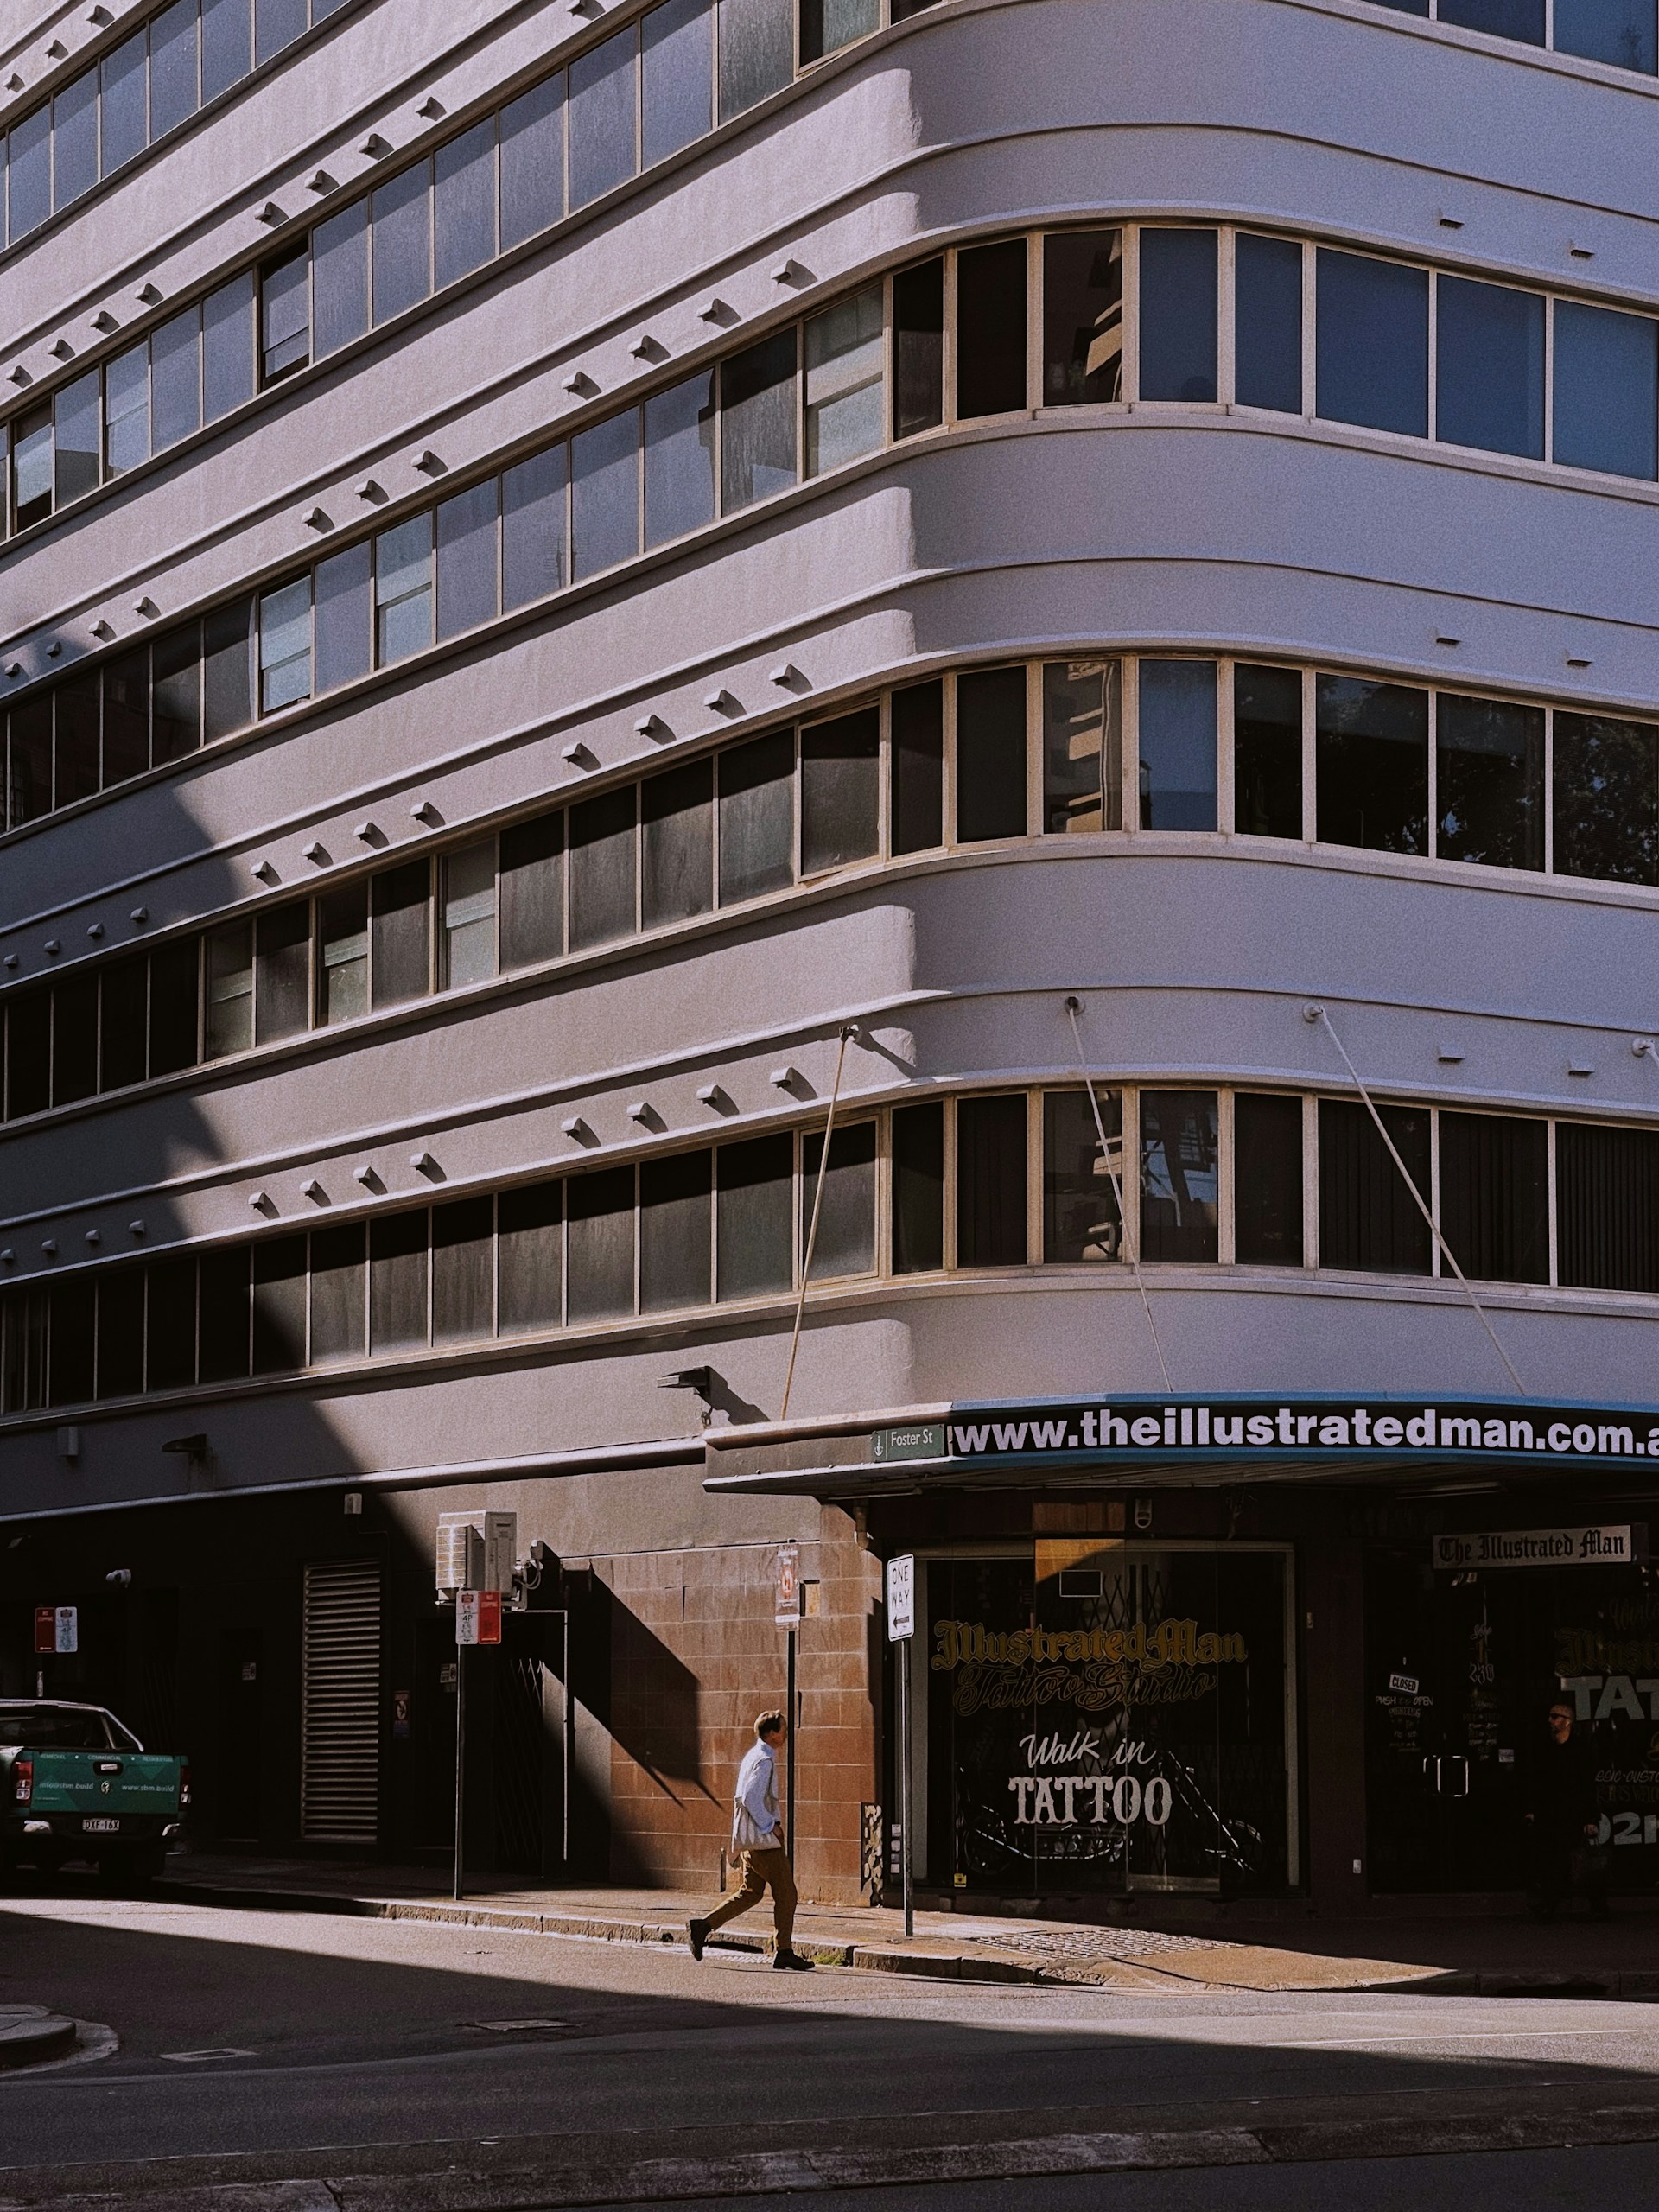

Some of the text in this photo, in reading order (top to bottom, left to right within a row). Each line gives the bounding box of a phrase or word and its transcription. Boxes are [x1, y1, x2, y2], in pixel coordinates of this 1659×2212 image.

[891, 1428, 933, 1446] Foster St
[1437, 1529, 1624, 1565] The Illustrated Man
[892, 1565, 909, 1585] ONE
[892, 1589, 909, 1609] WAY
[931, 1618, 1245, 1672] Illustrated Man
[1391, 1676, 1417, 1692] CLOSED
[1468, 1661, 1496, 1685] 230
[953, 1662, 1217, 1716] Tattoo Studio
[1375, 1695, 1397, 1706] PUSH
[1413, 1695, 1433, 1706] OPEN
[1019, 1731, 1158, 1769] Walk in
[121, 1783, 175, 1793] www.sbm.build
[1007, 1775, 1173, 1826] TATTOO
